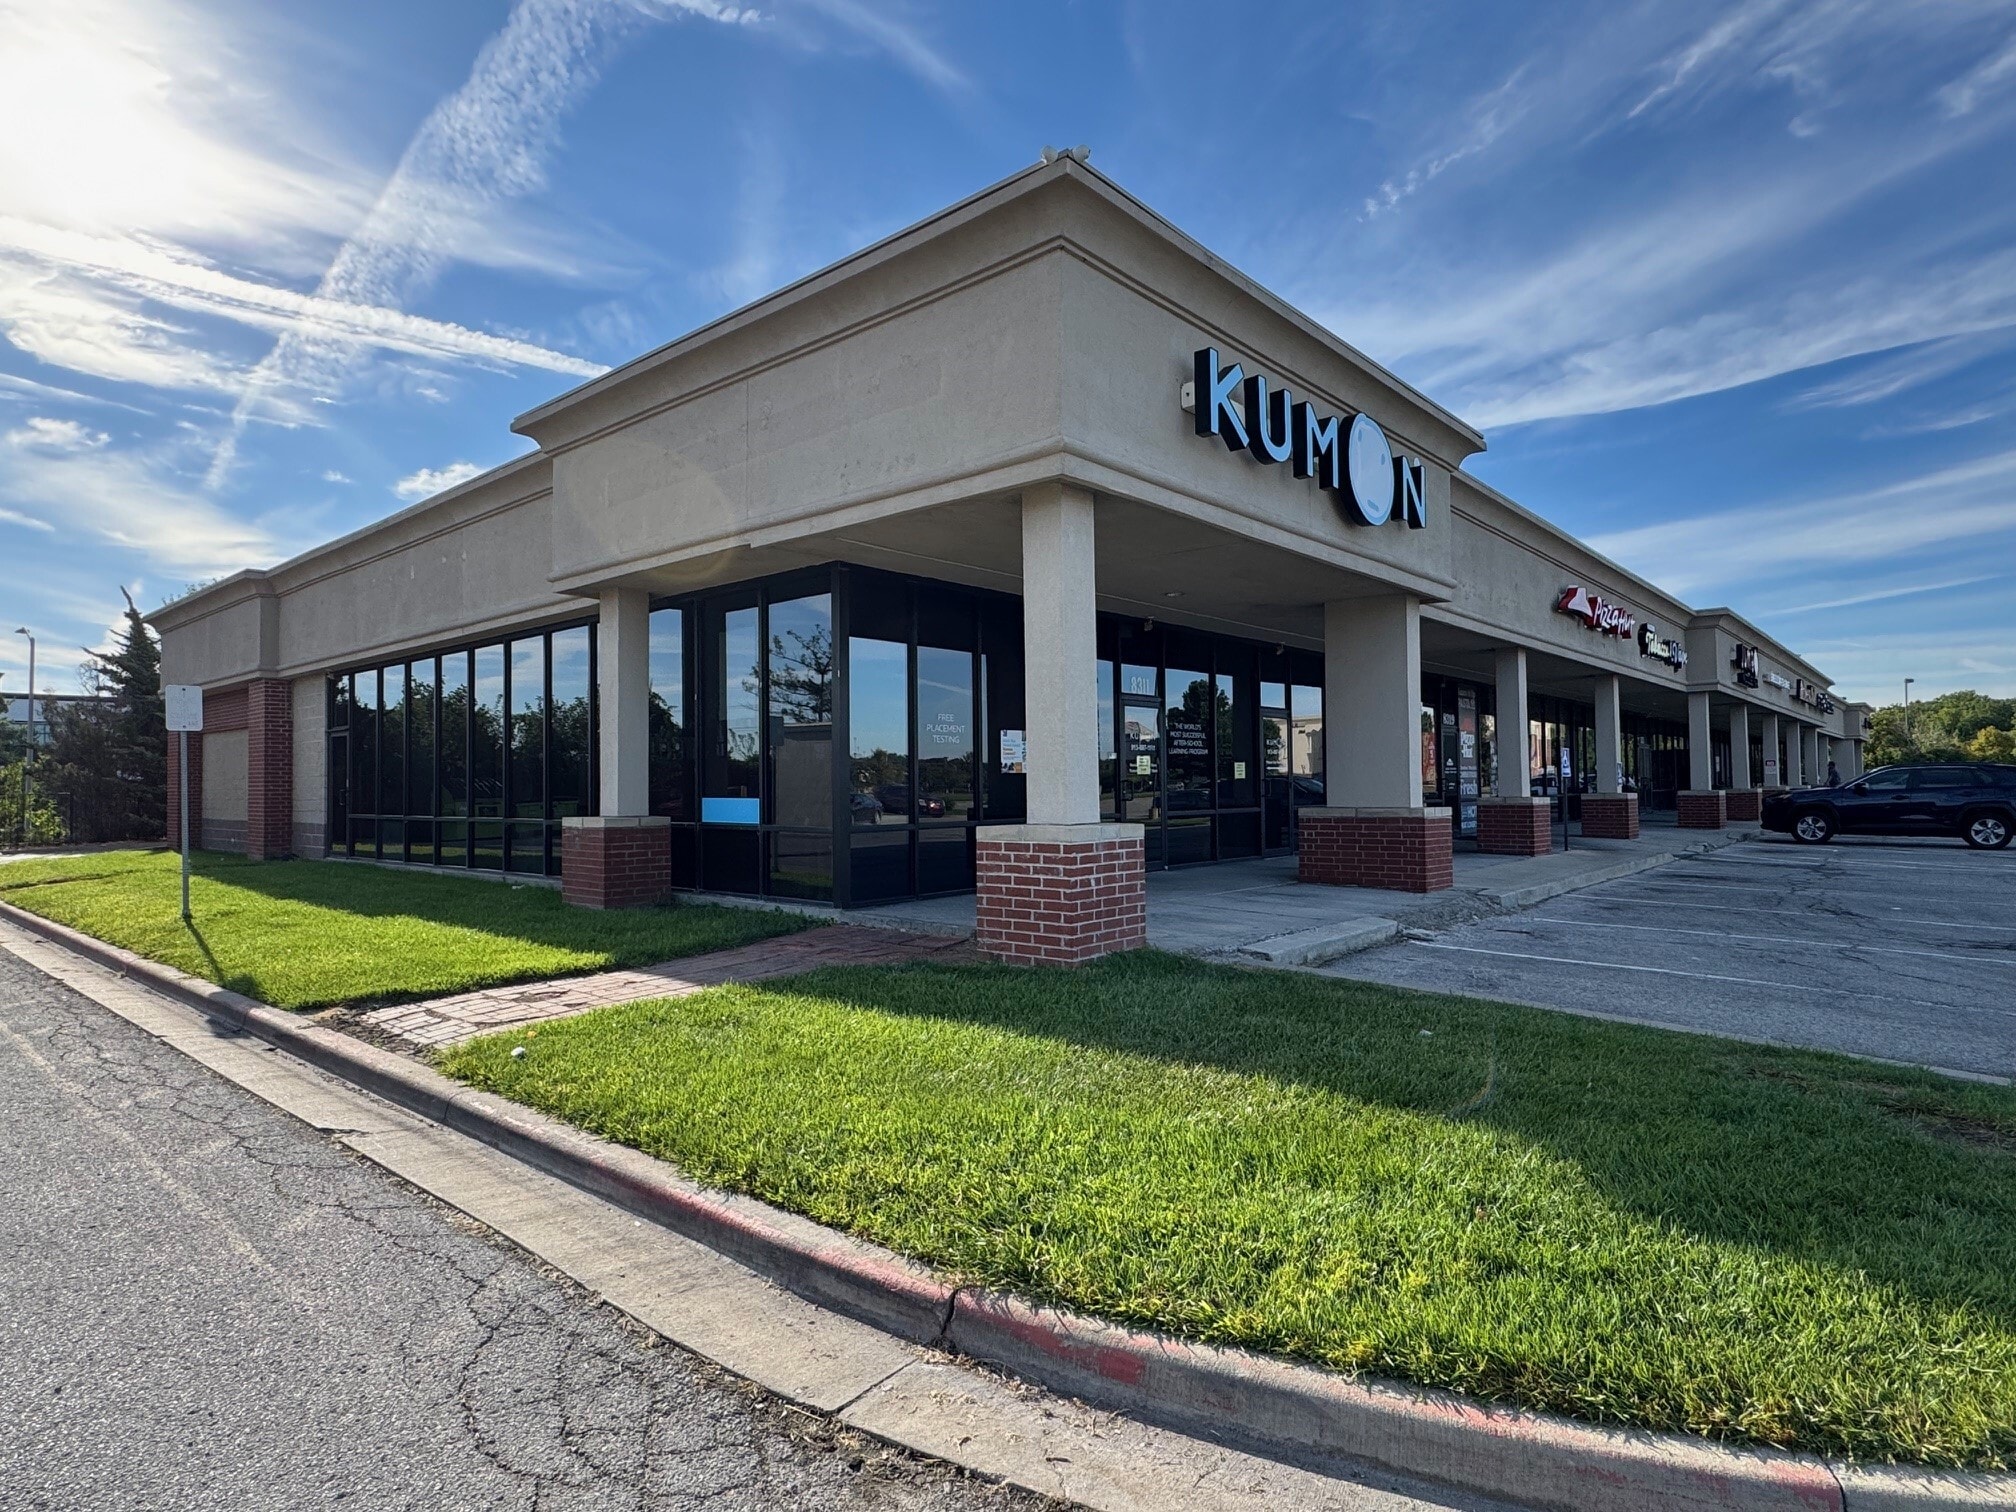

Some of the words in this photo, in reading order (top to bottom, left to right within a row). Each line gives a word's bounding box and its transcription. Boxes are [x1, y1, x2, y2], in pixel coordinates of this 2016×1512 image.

[1194, 346, 1427, 529] KUMON
[1593, 596, 1619, 629] Pizza
[1618, 609, 1636, 635] Hut
[1131, 676, 1150, 695] 8311
[937, 713, 955, 722] FREE
[926, 723, 965, 734] PLACEMENT
[1174, 722, 1183, 730] THE
[932, 734, 960, 744] TESTING
[1182, 731, 1207, 739] SUCCESSFUL
[1168, 747, 1188, 755] LEARNING
